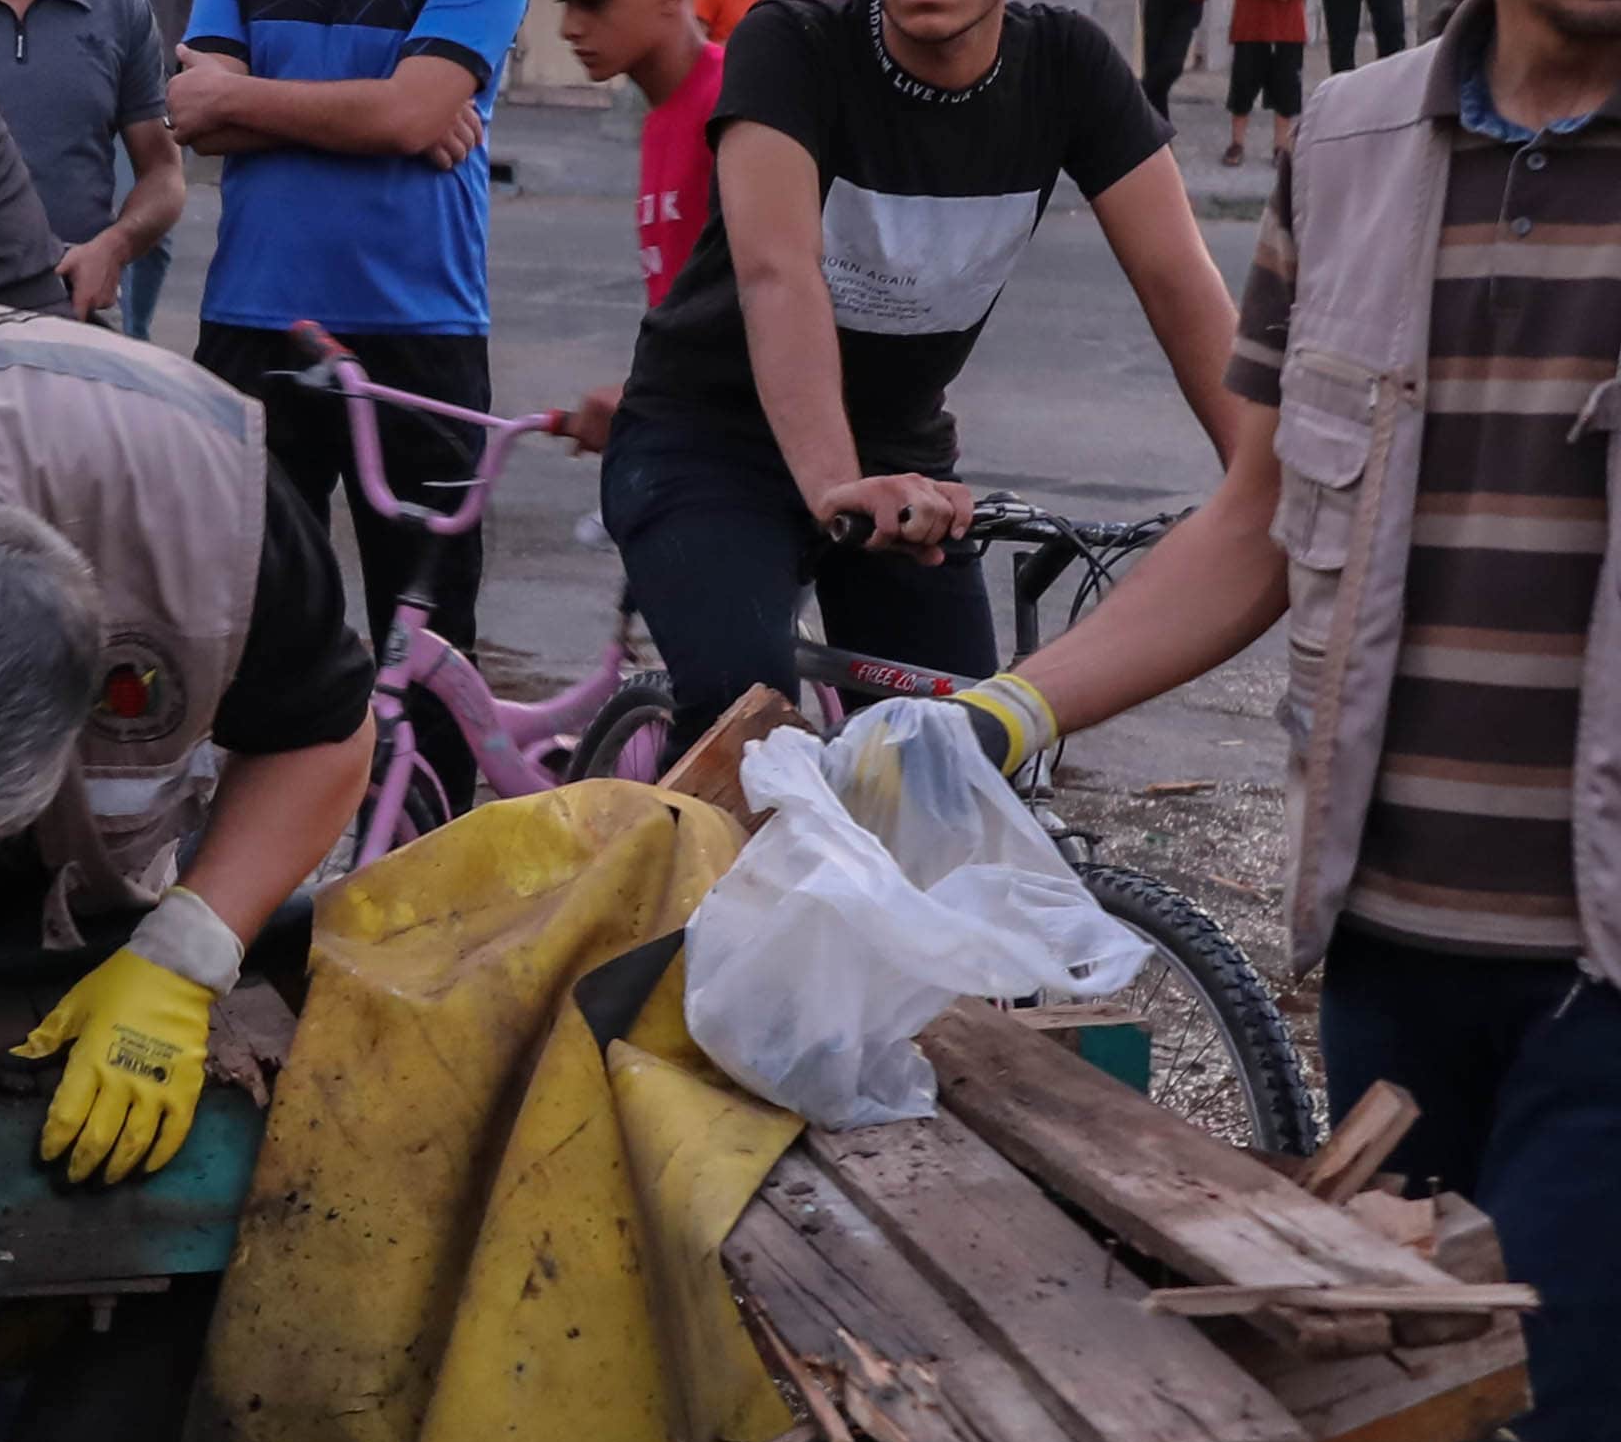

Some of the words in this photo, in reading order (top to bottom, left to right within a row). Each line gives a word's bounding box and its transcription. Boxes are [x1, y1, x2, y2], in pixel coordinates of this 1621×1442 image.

[892, 71, 936, 103] LIVE
[867, 270, 918, 287] AGAIN
[857, 663, 897, 687] FREE
